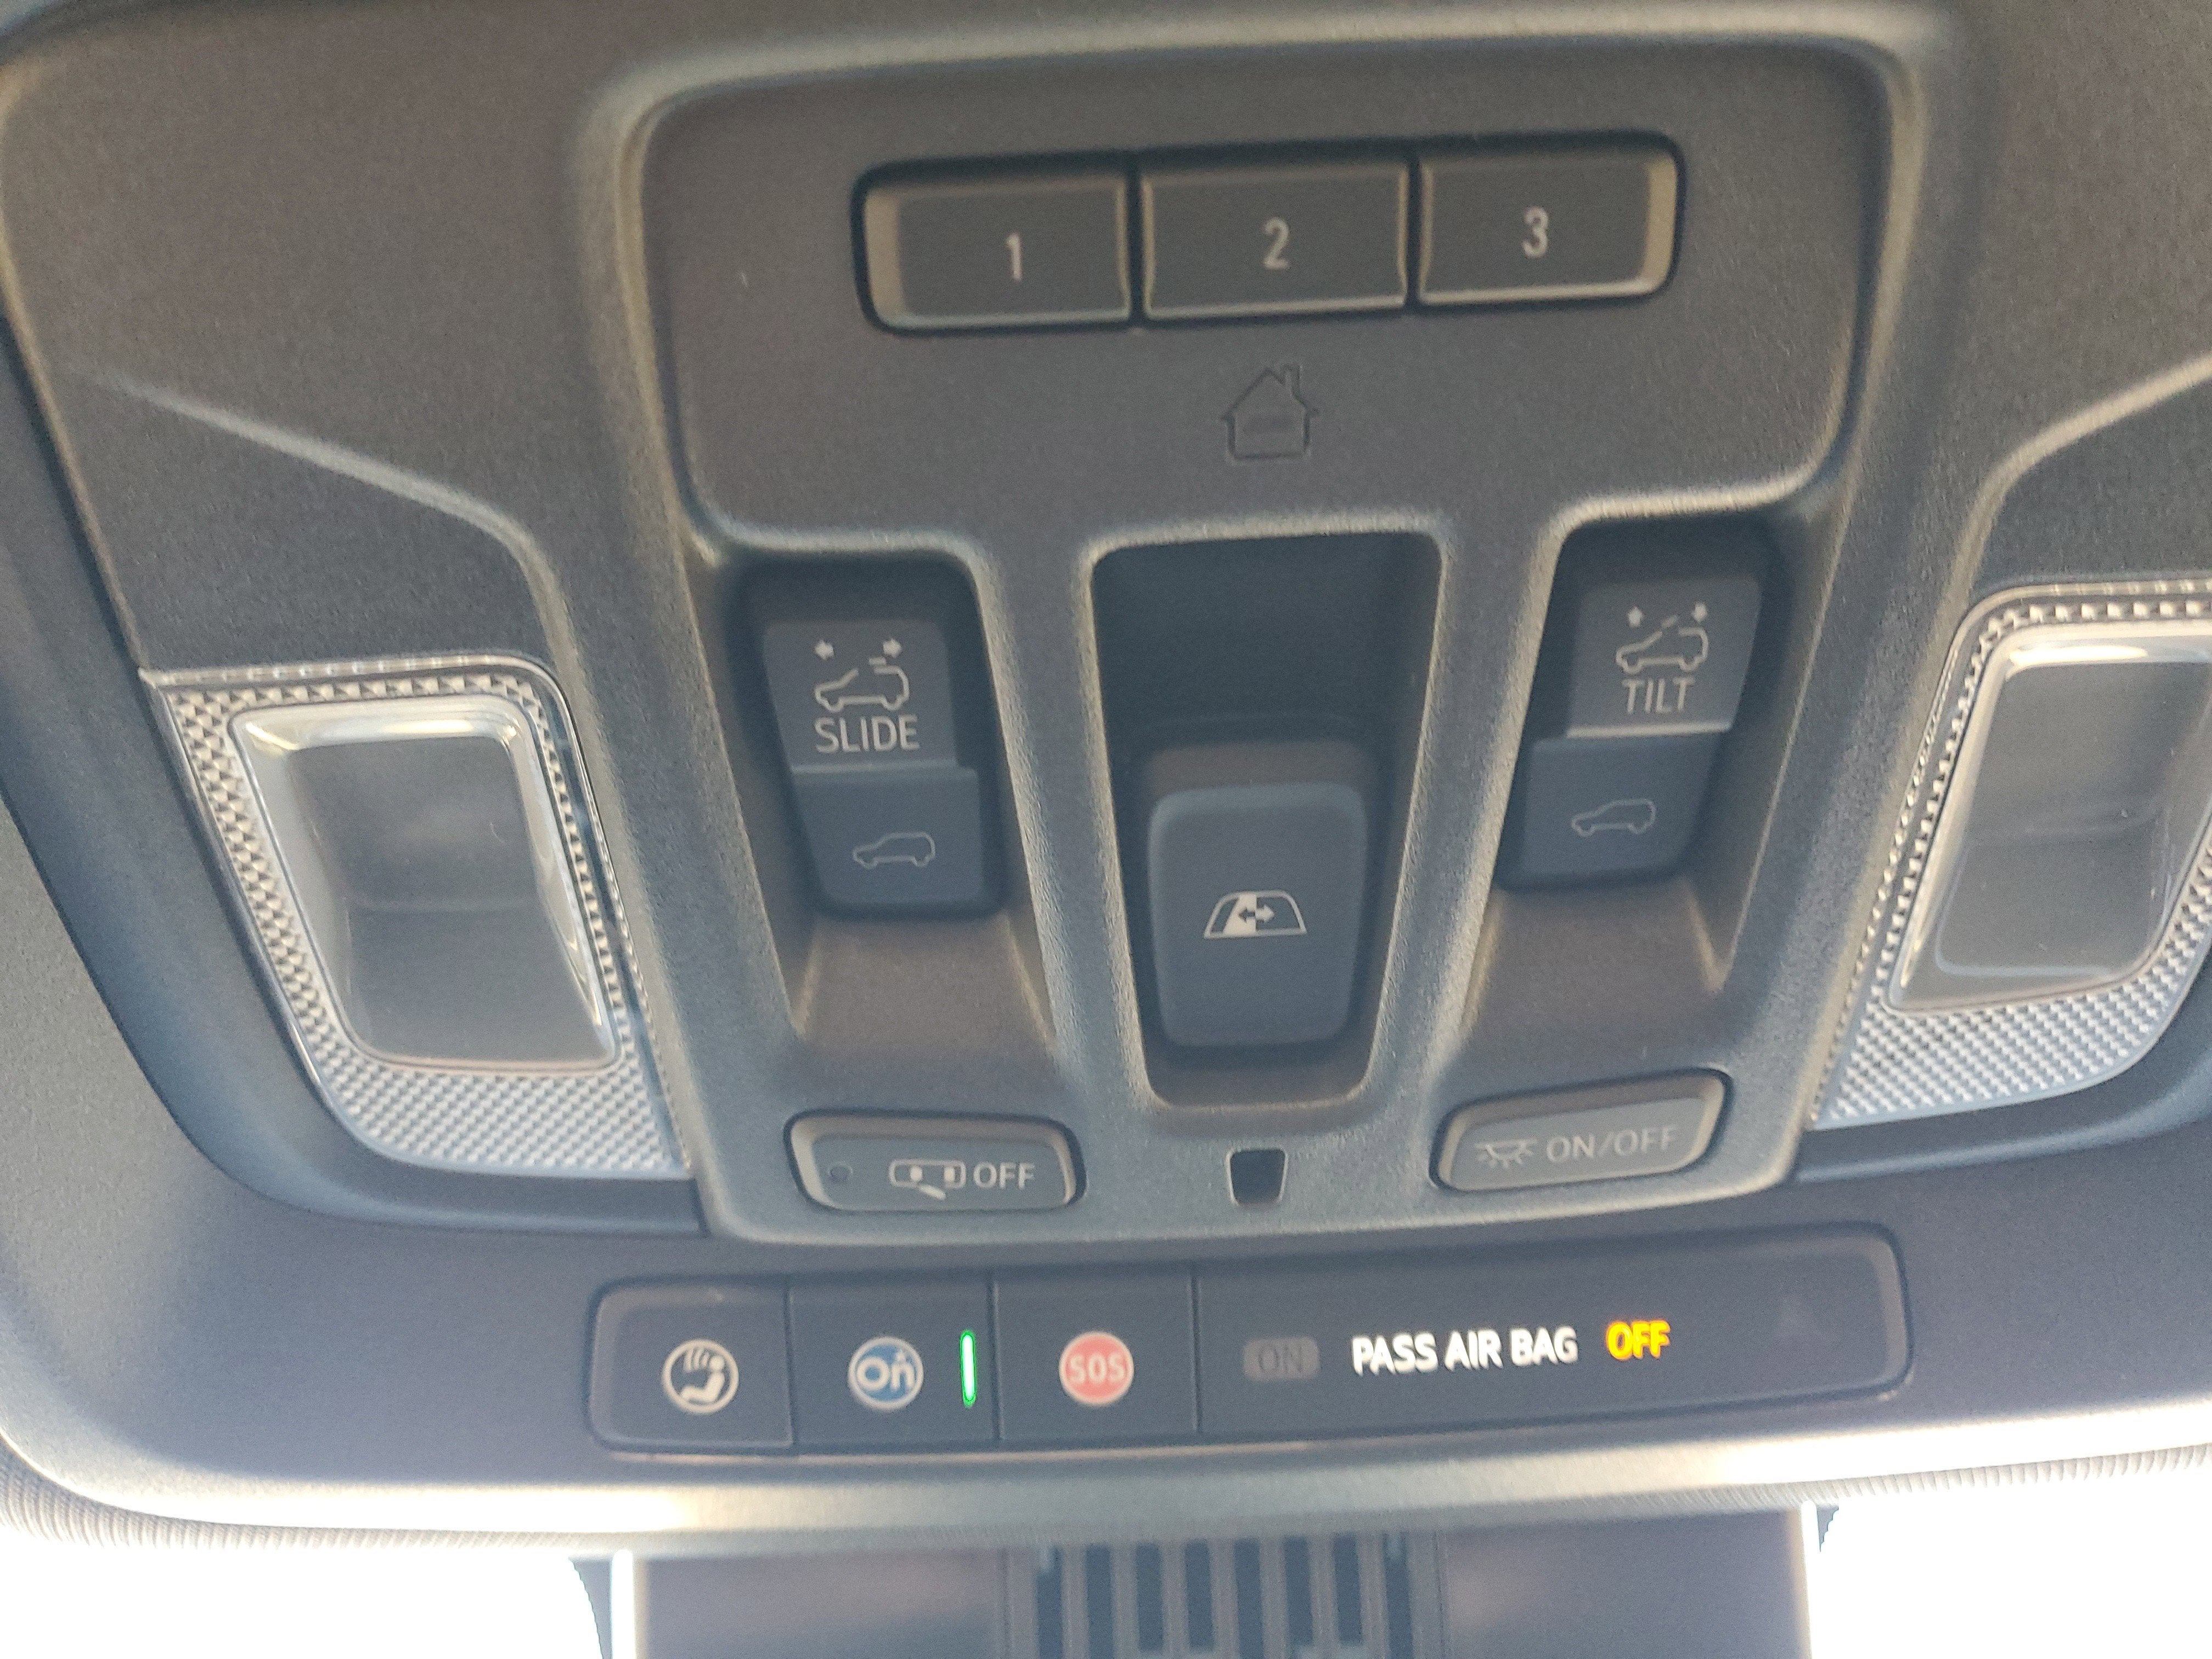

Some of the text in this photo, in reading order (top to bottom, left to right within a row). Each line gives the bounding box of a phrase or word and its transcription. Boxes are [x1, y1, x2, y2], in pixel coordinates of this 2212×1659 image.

[1263, 217, 1290, 270] 2
[1523, 206, 1549, 259] 3
[1004, 233, 1022, 282] 1
[1622, 675, 1695, 713] TILT
[814, 715, 919, 753] SLIDE
[1546, 1125, 1677, 1163] ON/OFF
[973, 1161, 1035, 1189] OFF
[1255, 1344, 1305, 1375] ON
[1352, 1327, 1578, 1375] PASS AIR BAG
[1606, 1320, 1670, 1361] OFF
[1069, 1352, 1125, 1385] SOS
